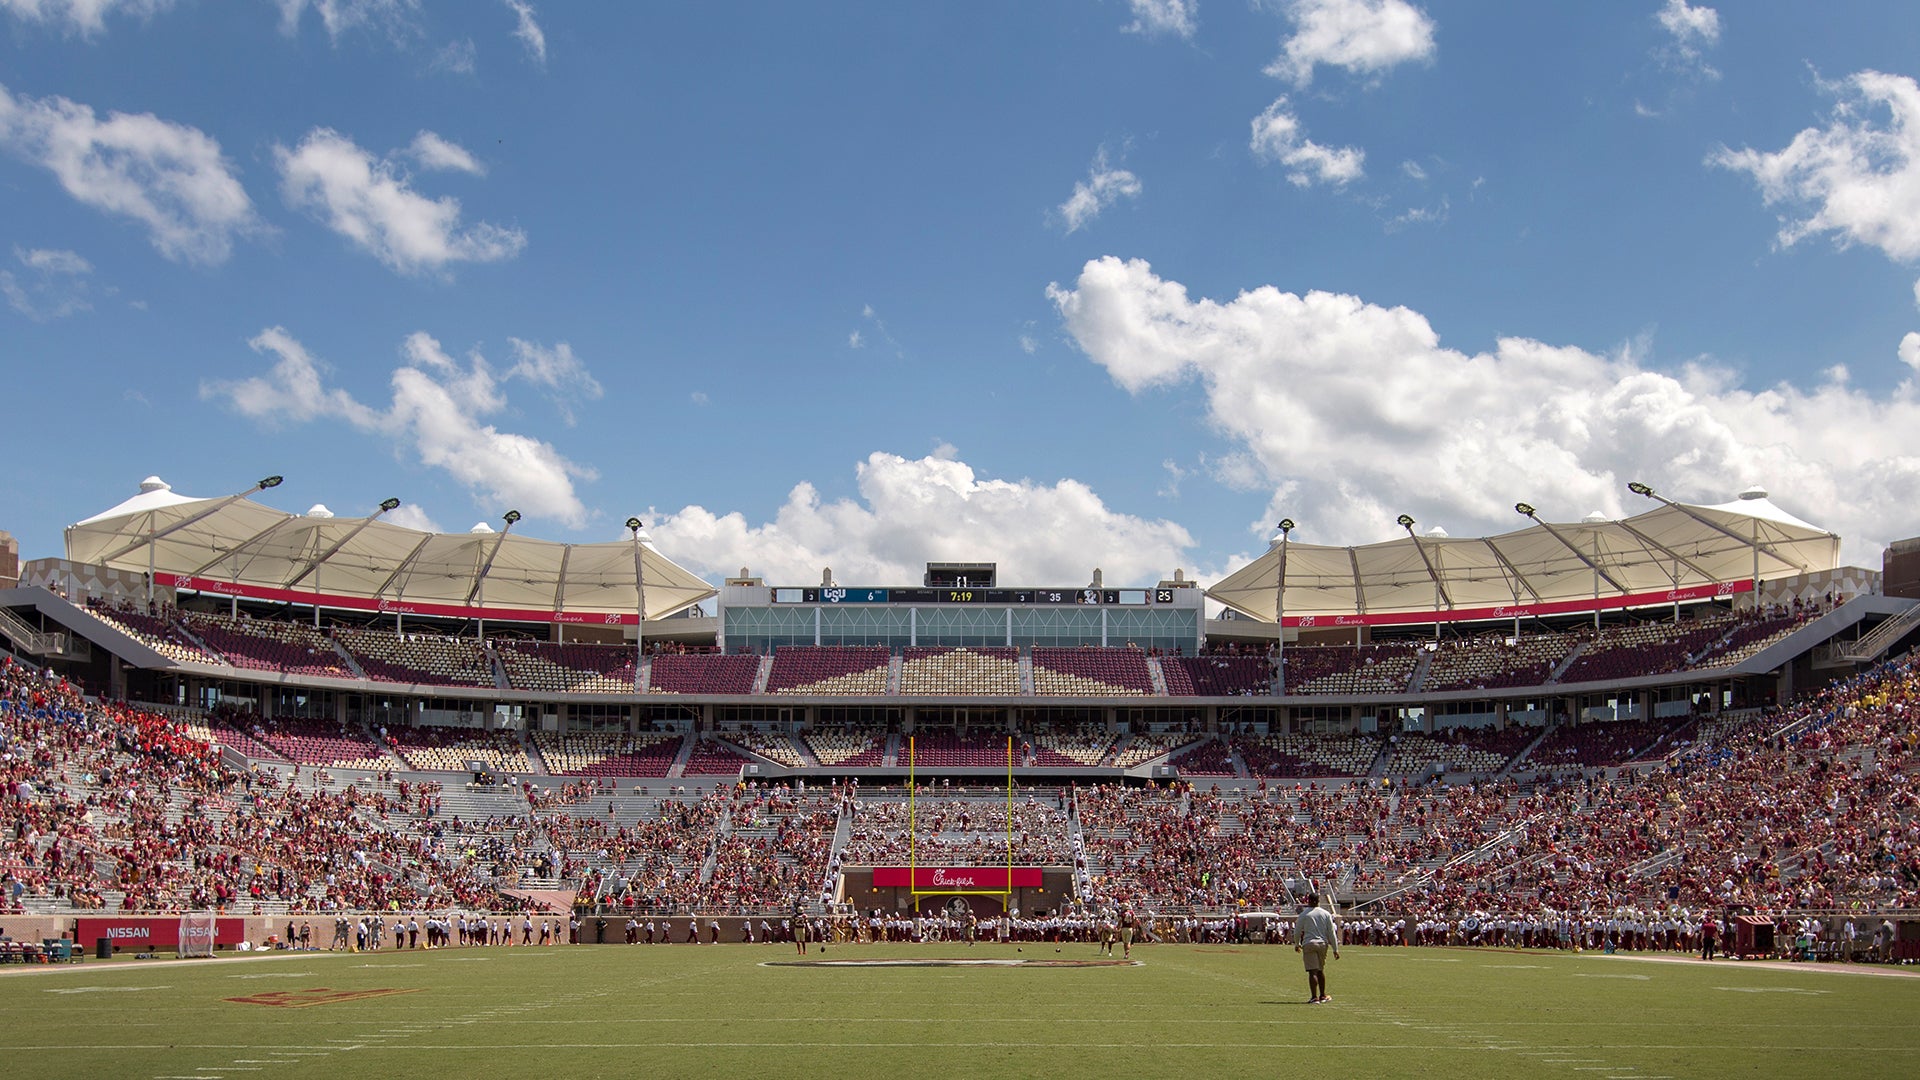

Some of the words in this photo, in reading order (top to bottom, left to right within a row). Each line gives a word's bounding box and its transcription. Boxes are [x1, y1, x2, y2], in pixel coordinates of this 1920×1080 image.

[868, 592, 874, 601] 6
[950, 592, 972, 602] 7:19
[1049, 593, 1061, 602] 35
[1158, 591, 1171, 601] 25
[106, 927, 150, 938] NISSAN
